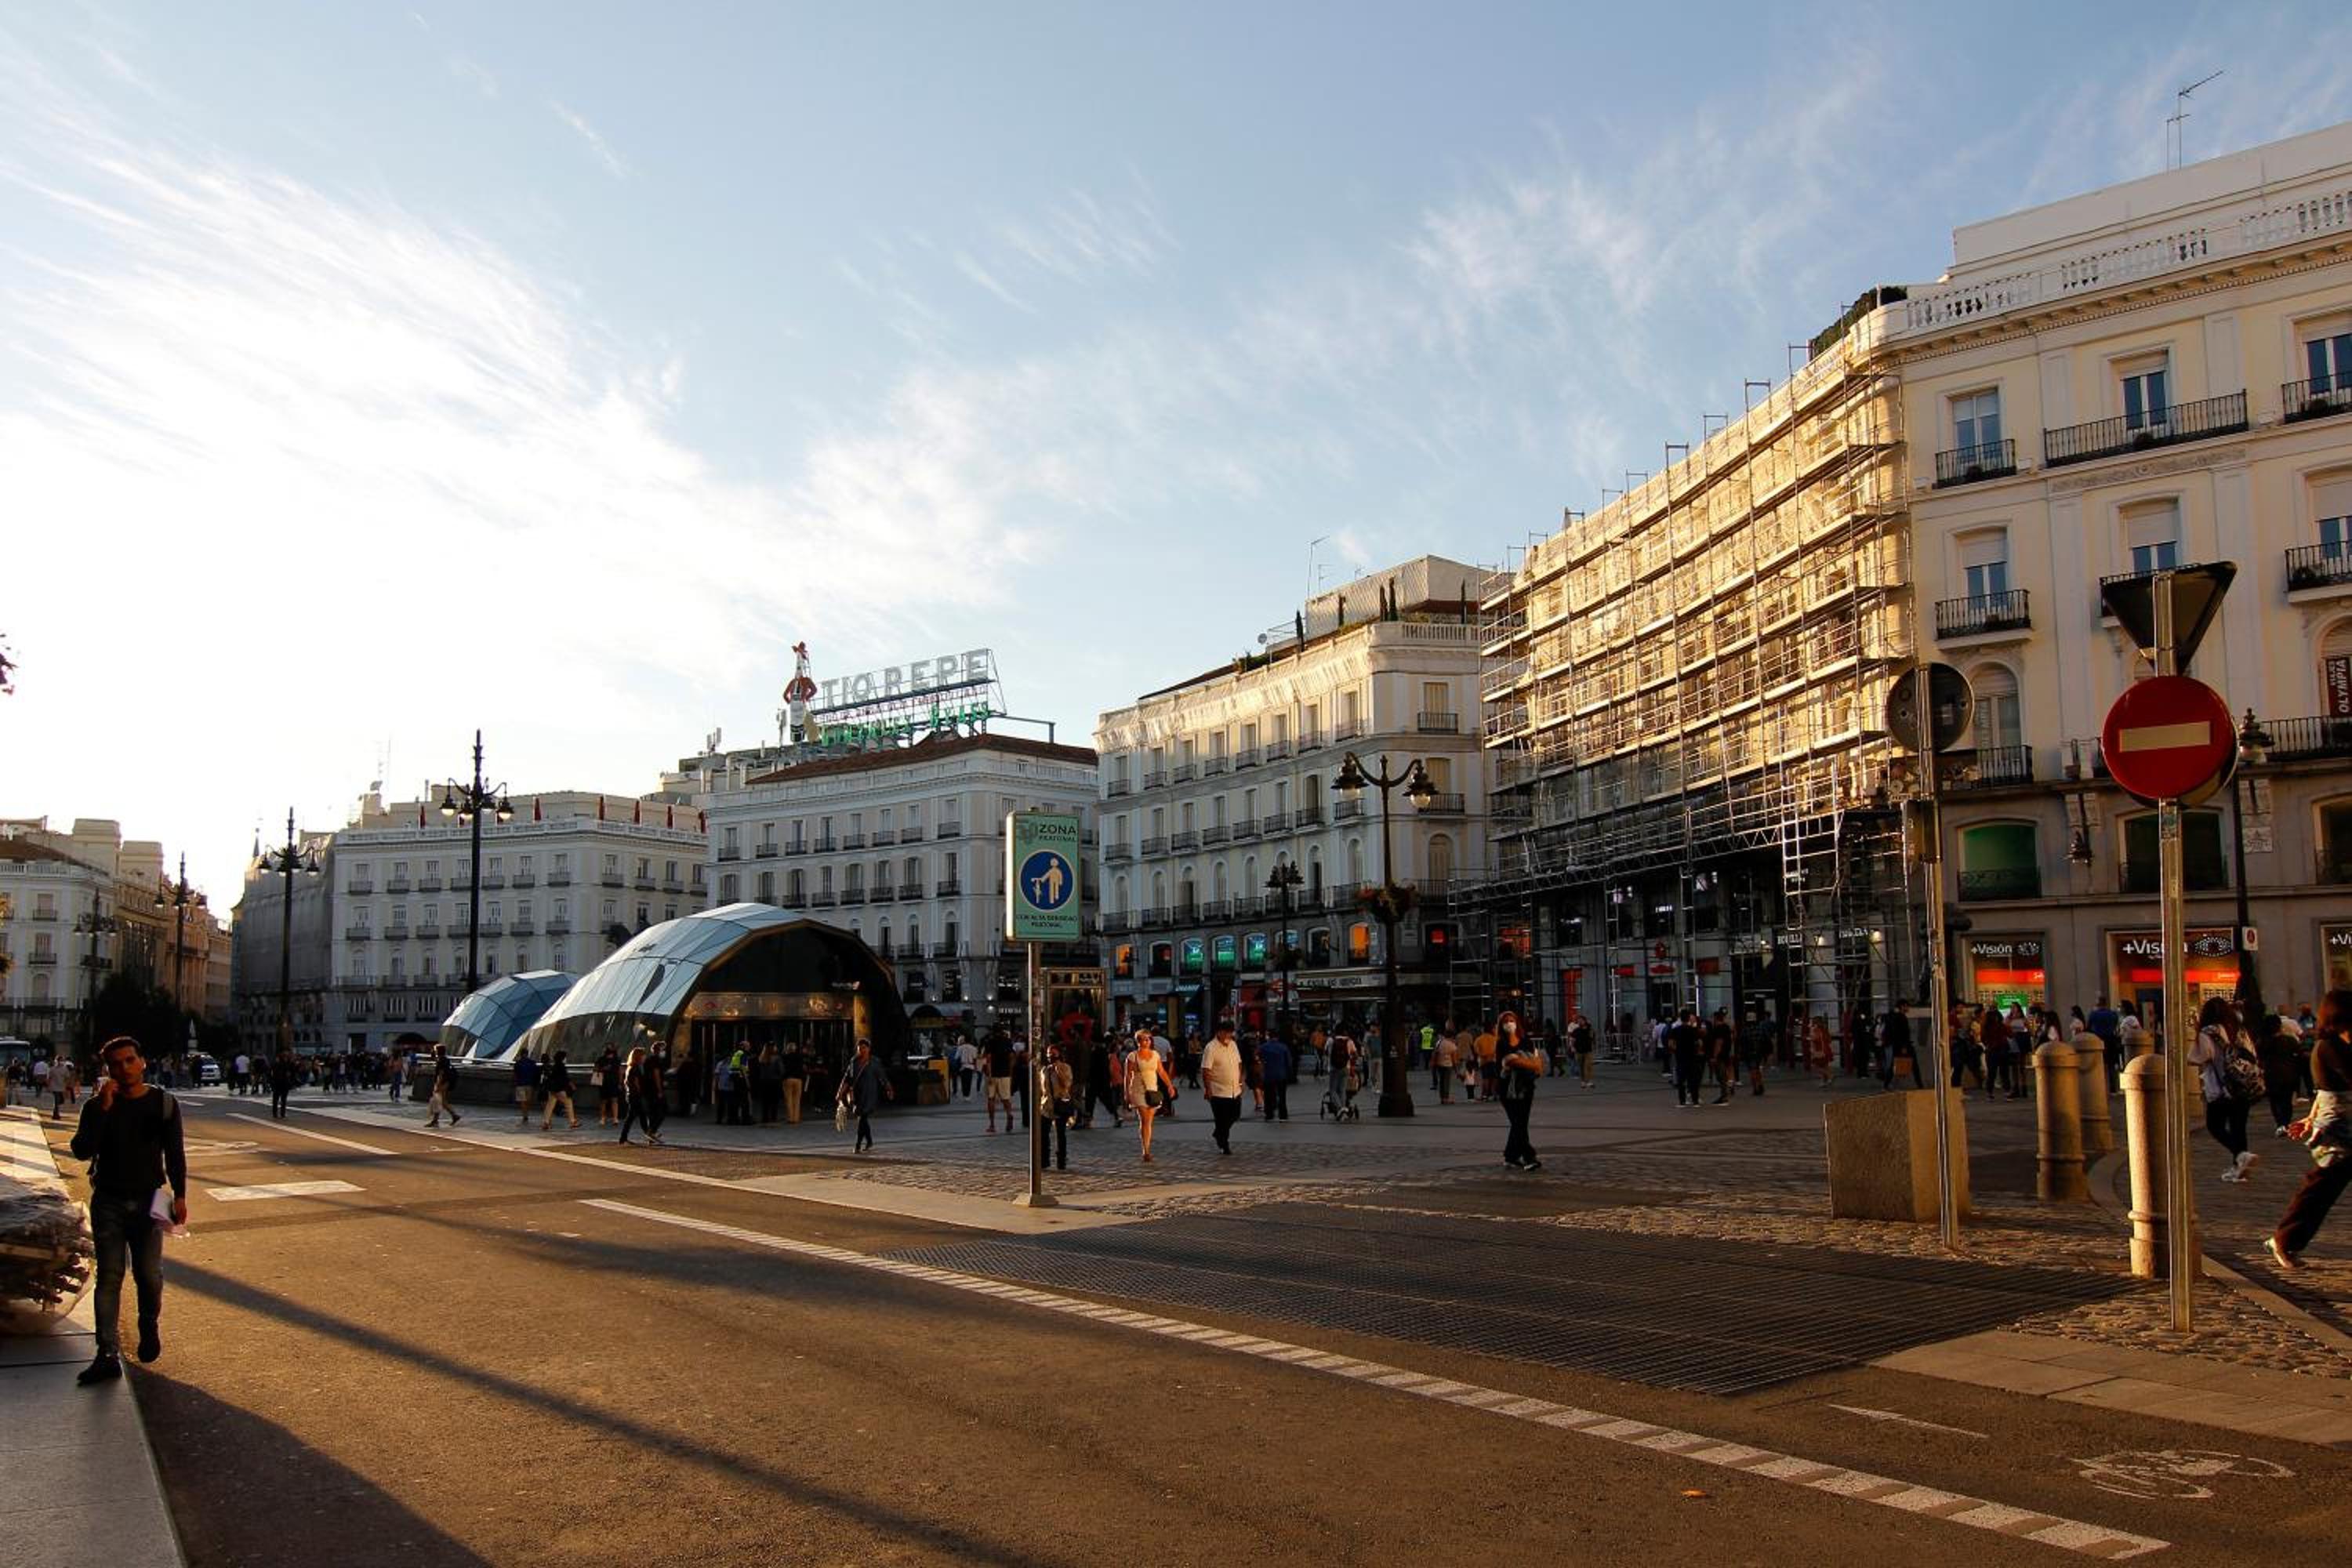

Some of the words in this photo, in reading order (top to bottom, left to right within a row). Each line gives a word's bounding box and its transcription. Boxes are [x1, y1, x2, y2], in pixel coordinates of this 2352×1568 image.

[2335, 659, 2350, 713] OLYMPIA
[1039, 823, 1076, 836] ZONA
[2122, 938, 2188, 954] +Vis
